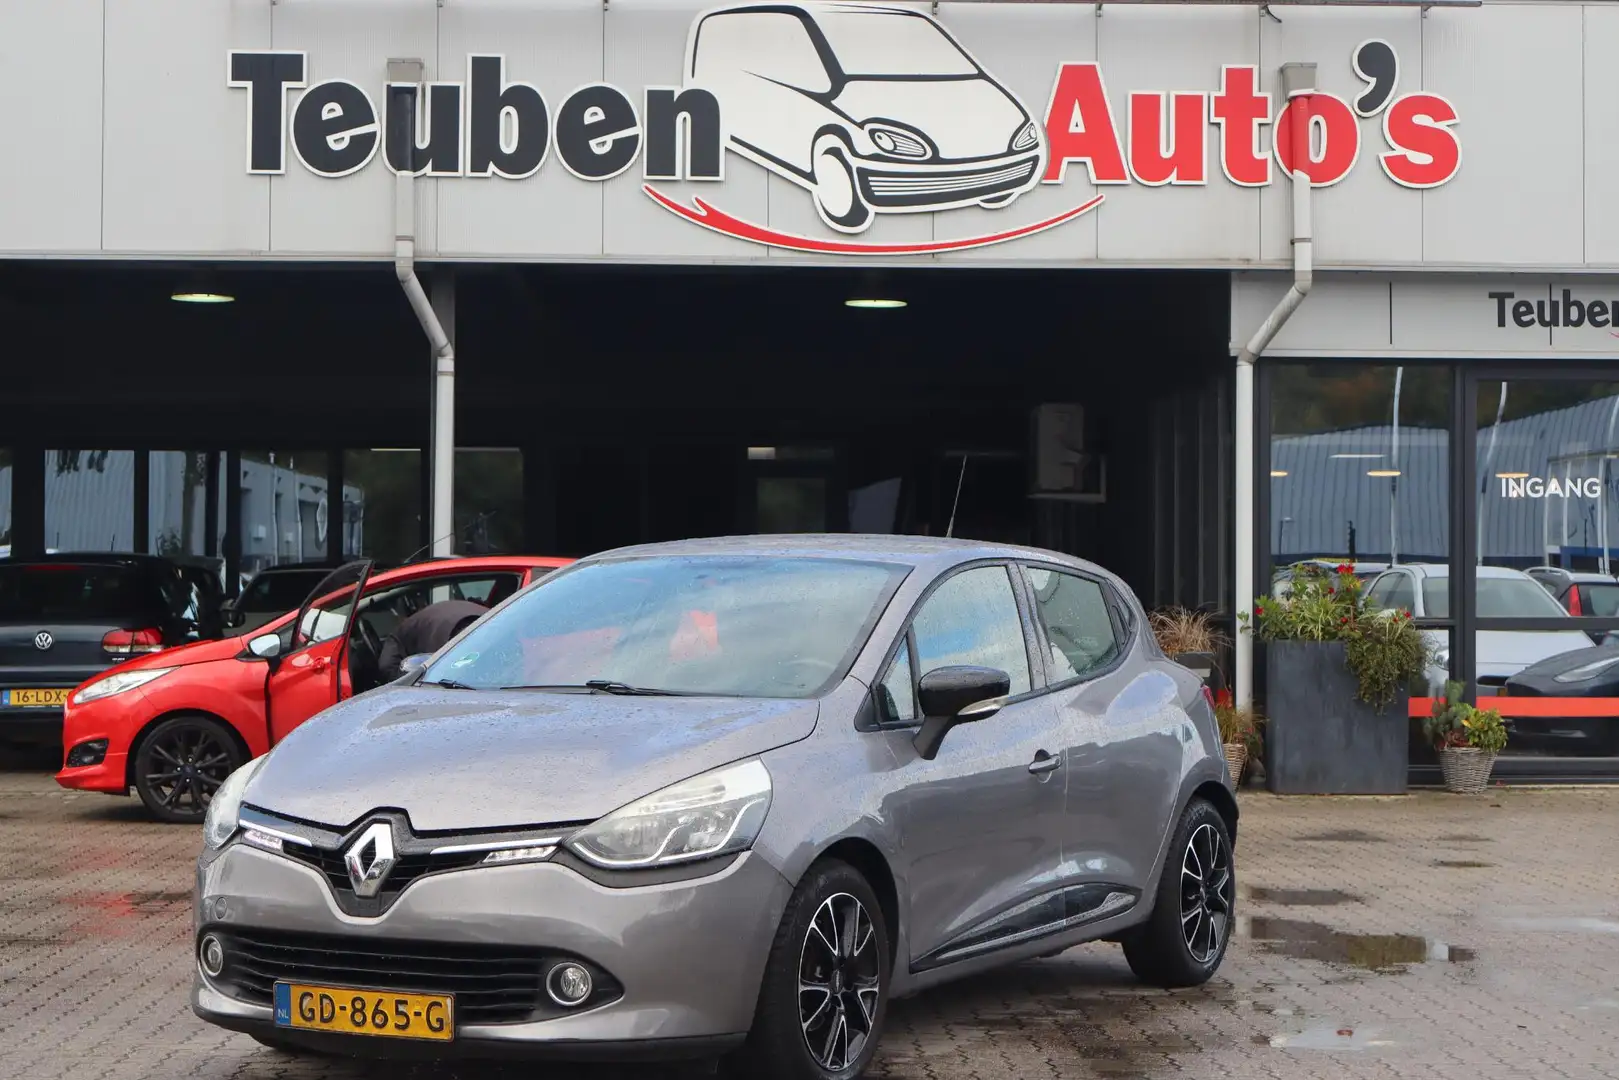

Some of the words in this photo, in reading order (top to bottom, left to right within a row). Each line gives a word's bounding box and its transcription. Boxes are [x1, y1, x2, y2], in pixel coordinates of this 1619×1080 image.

[229, 51, 723, 181] Teuben
[1042, 38, 1463, 188] Auto's
[1501, 477, 1602, 498] INGANG
[16, 690, 66, 703] 16-LDX-
[277, 1008, 289, 1020] NL
[299, 991, 444, 1032] GD-865-G
